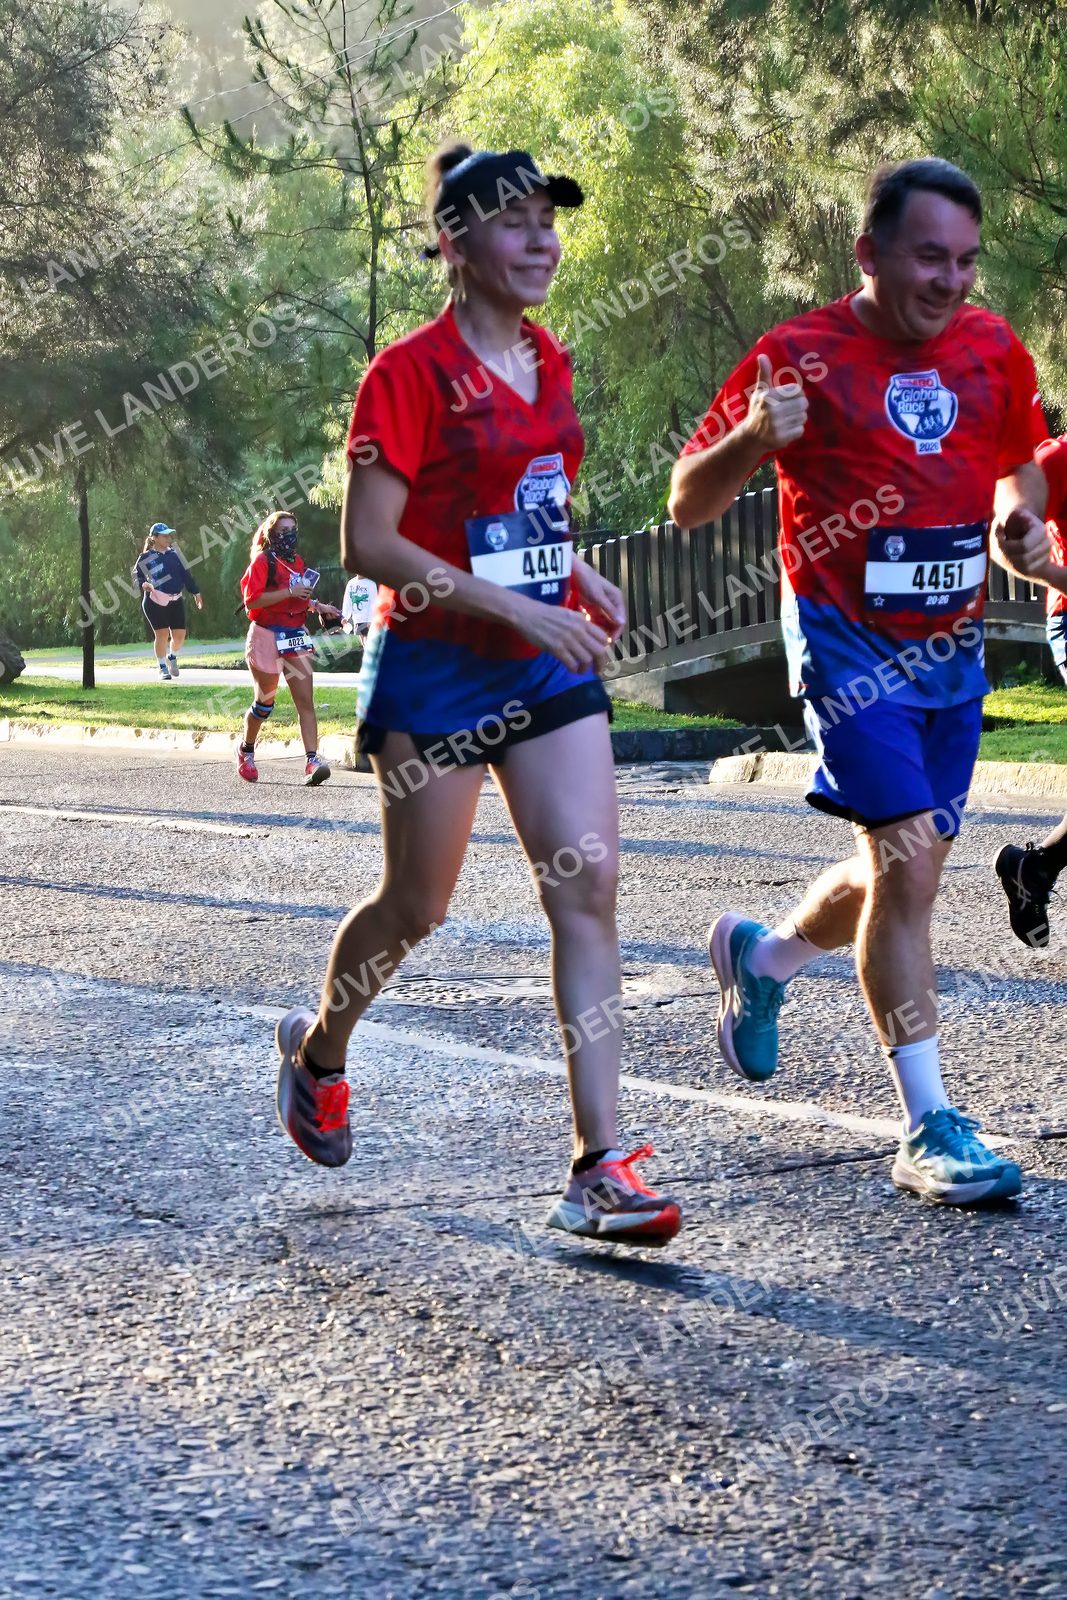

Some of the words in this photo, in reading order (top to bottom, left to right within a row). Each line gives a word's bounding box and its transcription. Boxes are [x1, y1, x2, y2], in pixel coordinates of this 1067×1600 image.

[901, 388, 938, 401] Global
[897, 400, 926, 413] Race
[919, 442, 939, 452] 2026
[912, 562, 964, 590] 4451
[288, 637, 305, 647] 4023
